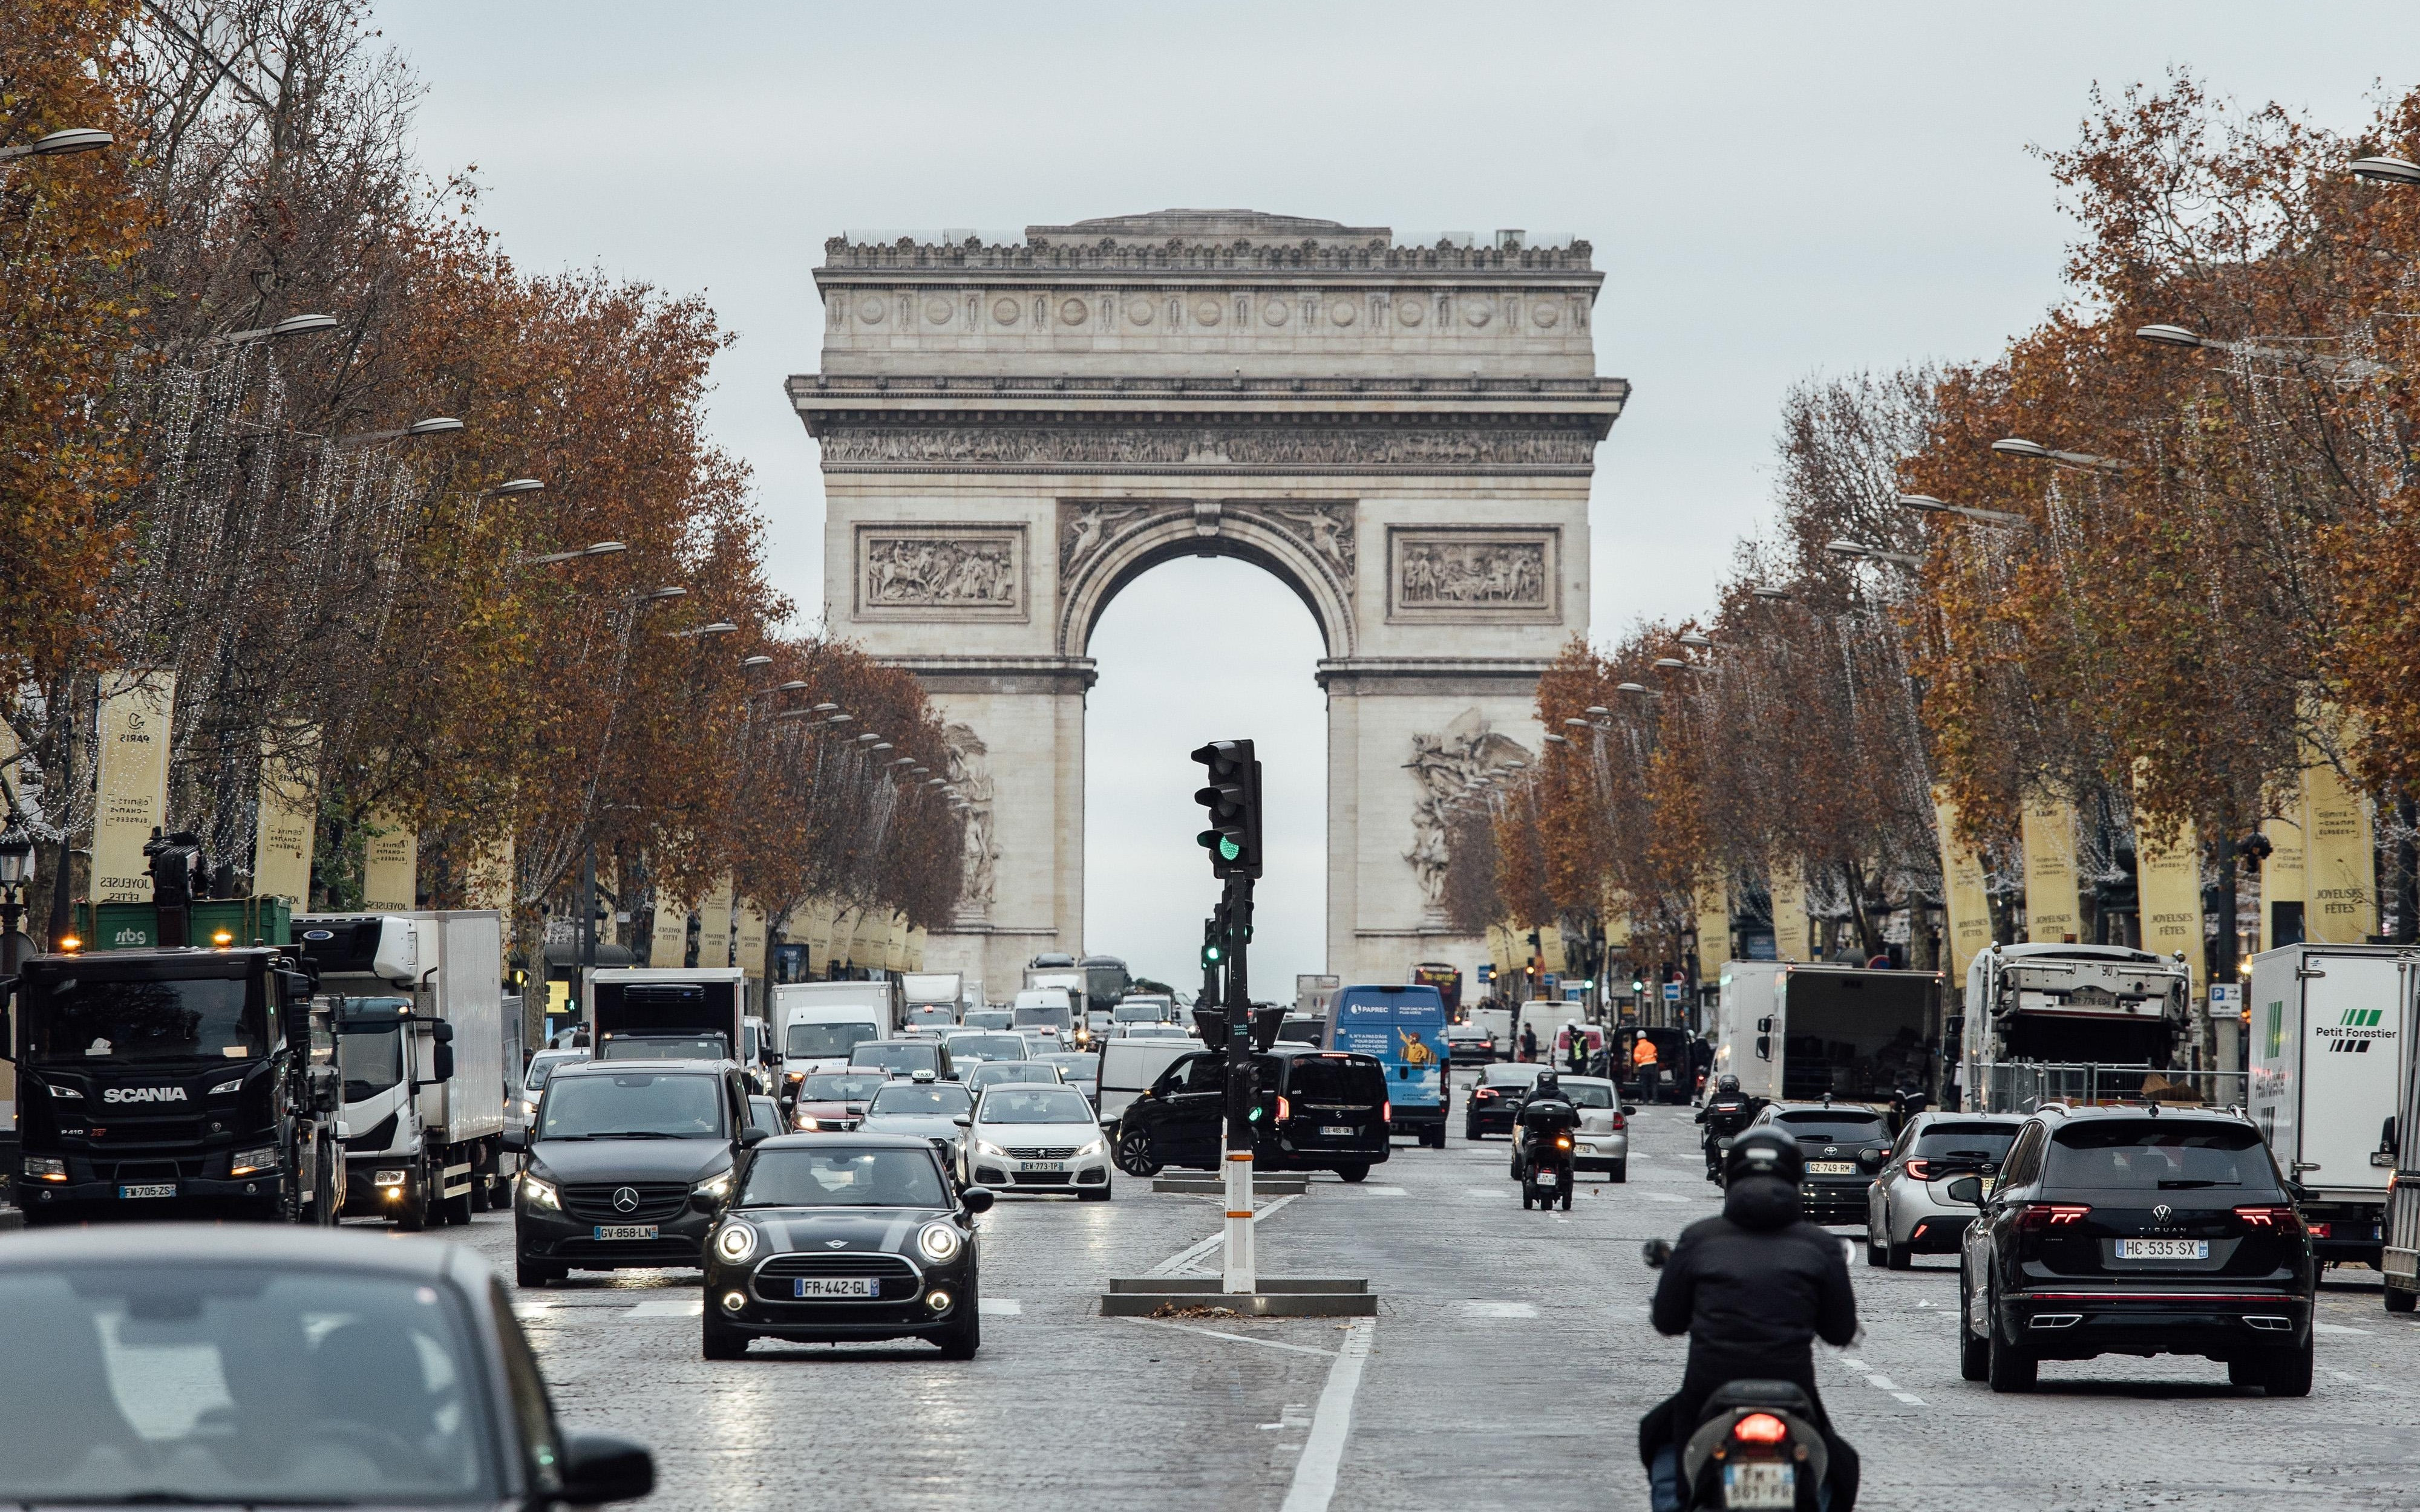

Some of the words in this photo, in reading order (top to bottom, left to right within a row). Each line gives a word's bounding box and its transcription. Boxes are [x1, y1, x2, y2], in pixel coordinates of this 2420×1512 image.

[2315, 888, 2364, 899] JOYEUSES
[2325, 902, 2355, 914] FÊTES
[2035, 914, 2072, 924] JOYEUSES
[2151, 913, 2194, 923] JOYEUSES
[115, 928, 146, 944] srbg
[2159, 926, 2186, 936] FÊTES
[2317, 1028, 2343, 1037] Petit
[2346, 1028, 2396, 1038] Forestier
[103, 1087, 188, 1103] SCANIA
[601, 1228, 651, 1237] GV-858-LN
[2126, 1242, 2195, 1255] HC-535-SX
[805, 1282, 868, 1294] FR-442-GL
